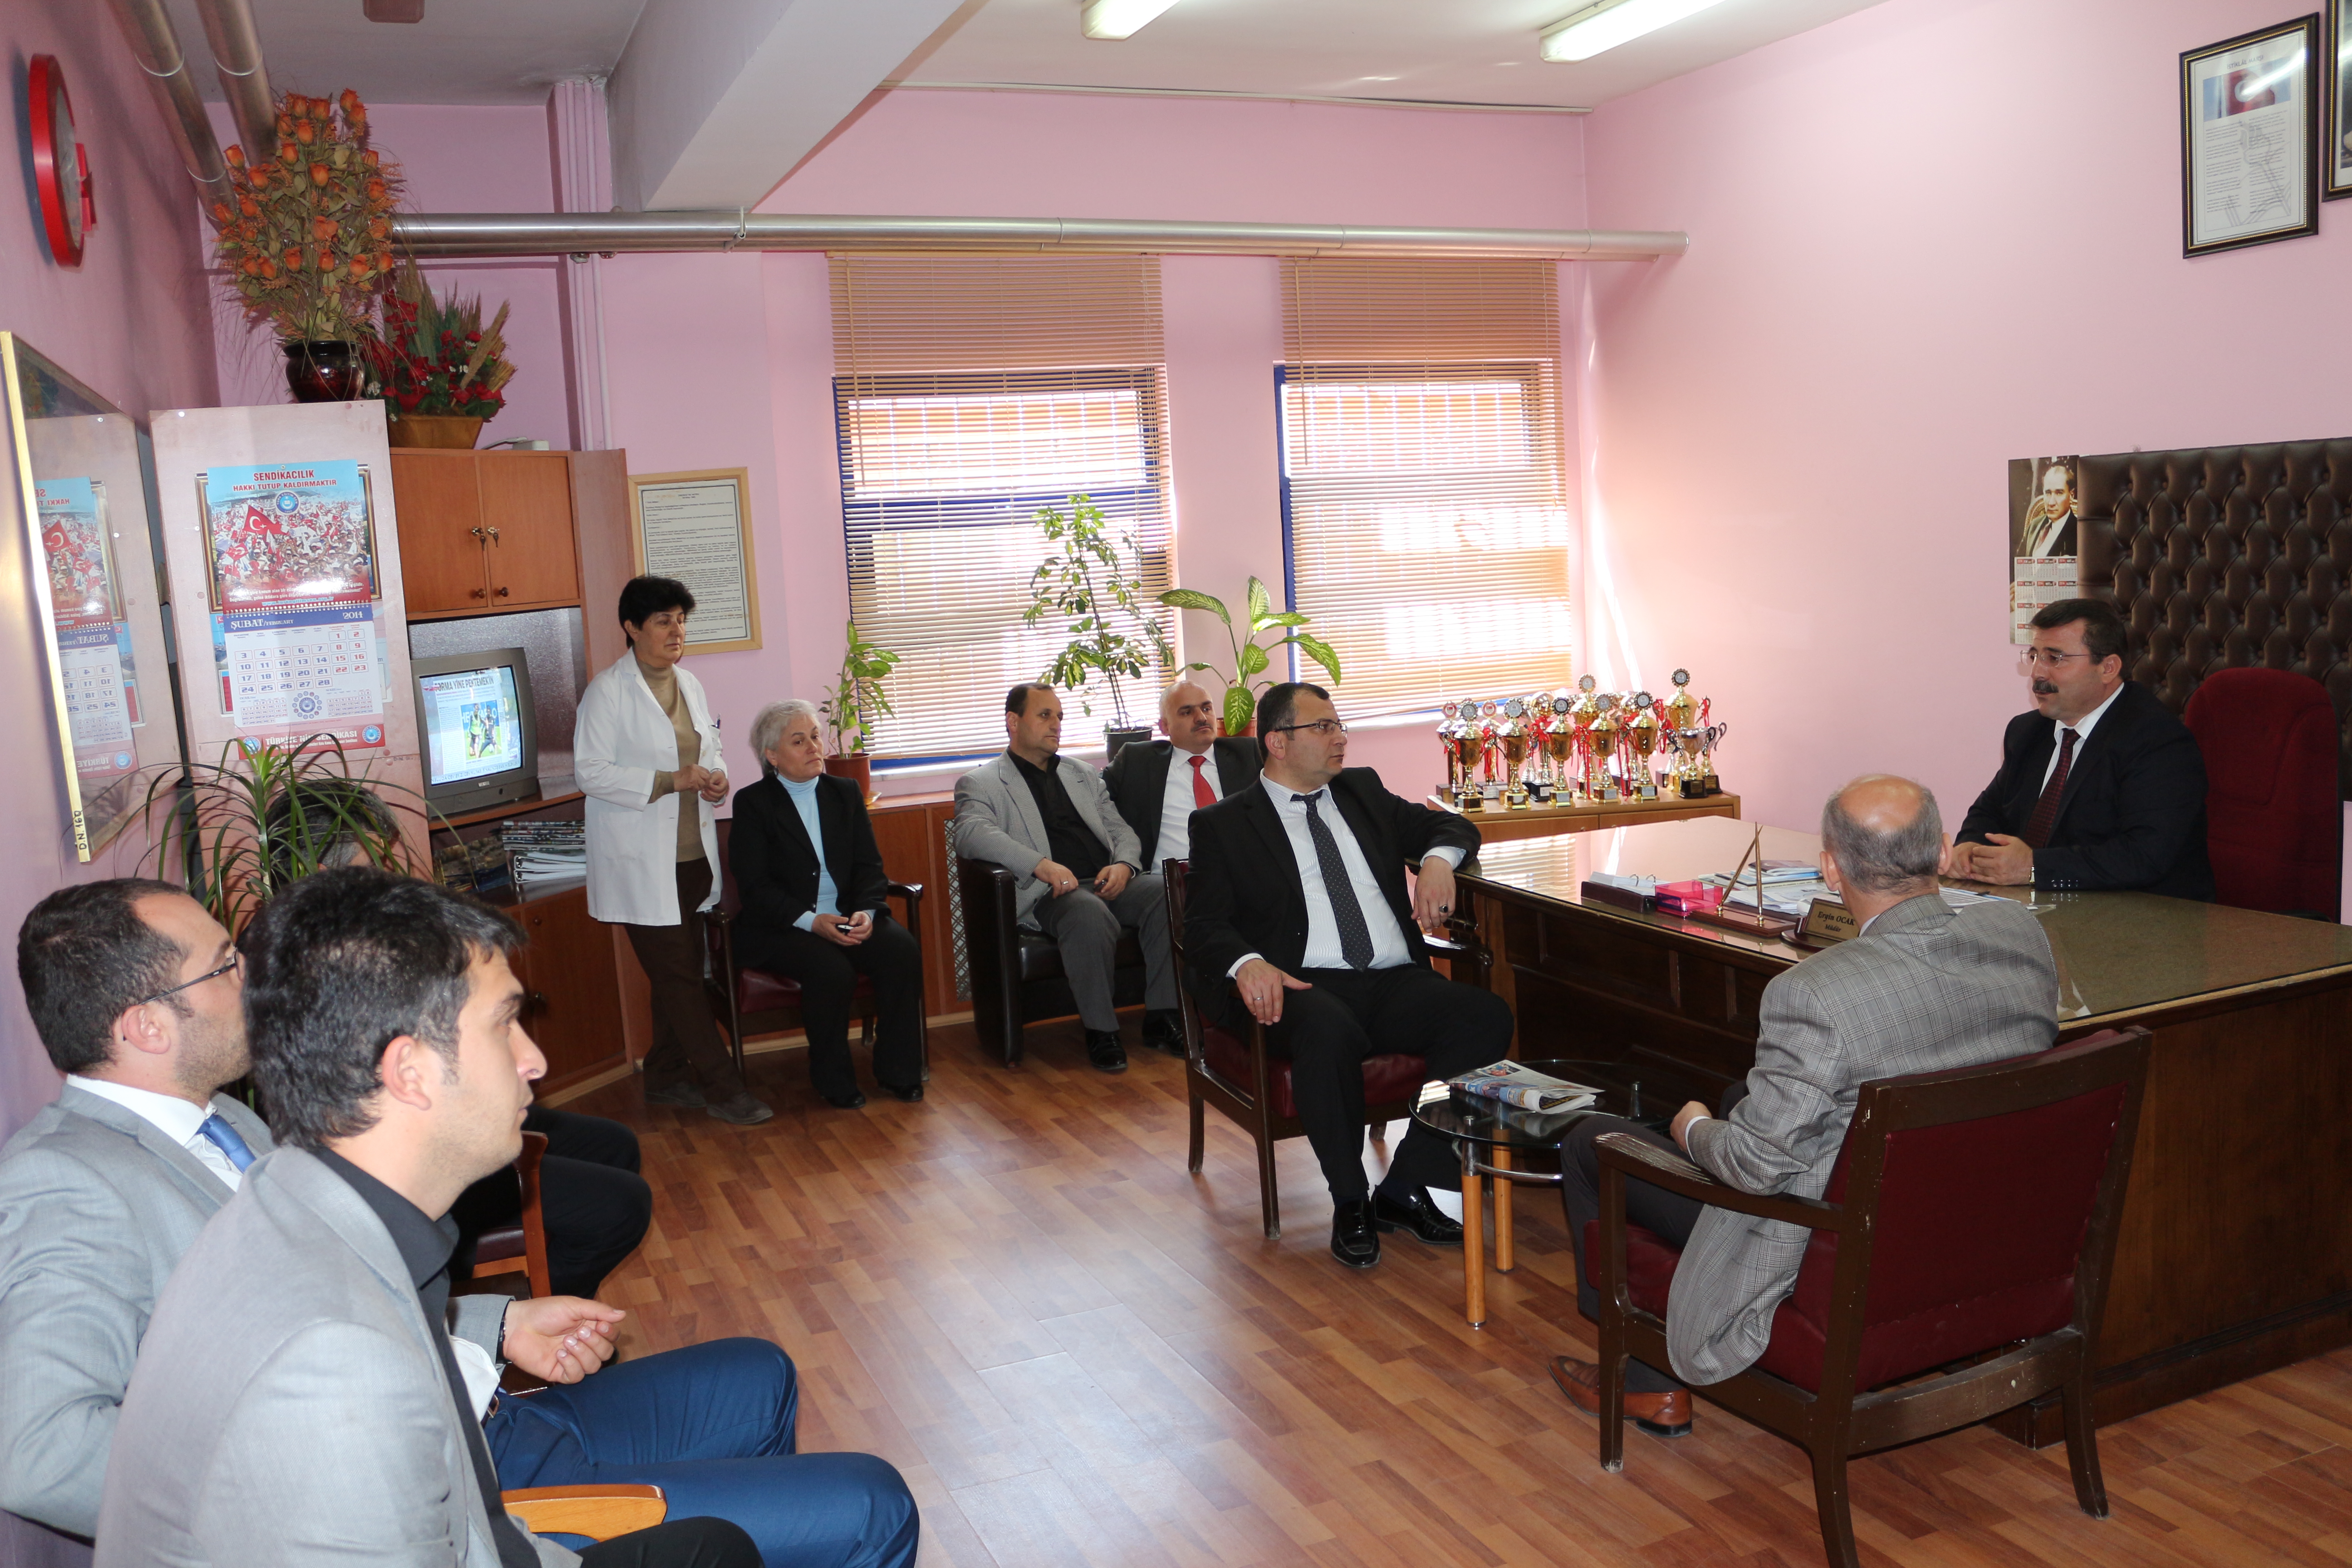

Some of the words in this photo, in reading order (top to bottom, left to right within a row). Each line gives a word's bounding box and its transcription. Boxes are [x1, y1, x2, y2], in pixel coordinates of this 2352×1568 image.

[254, 470, 314, 481] SENDİKACILIK
[284, 480, 337, 489] KALDIRMAKTIR
[343, 611, 363, 619] 2014
[454, 679, 465, 689] YİNE
[316, 731, 357, 740] SENDİKASI
[1818, 911, 1835, 922] Ergin
[1836, 916, 1855, 926] OCAK
[1824, 924, 1842, 932] Müdür
